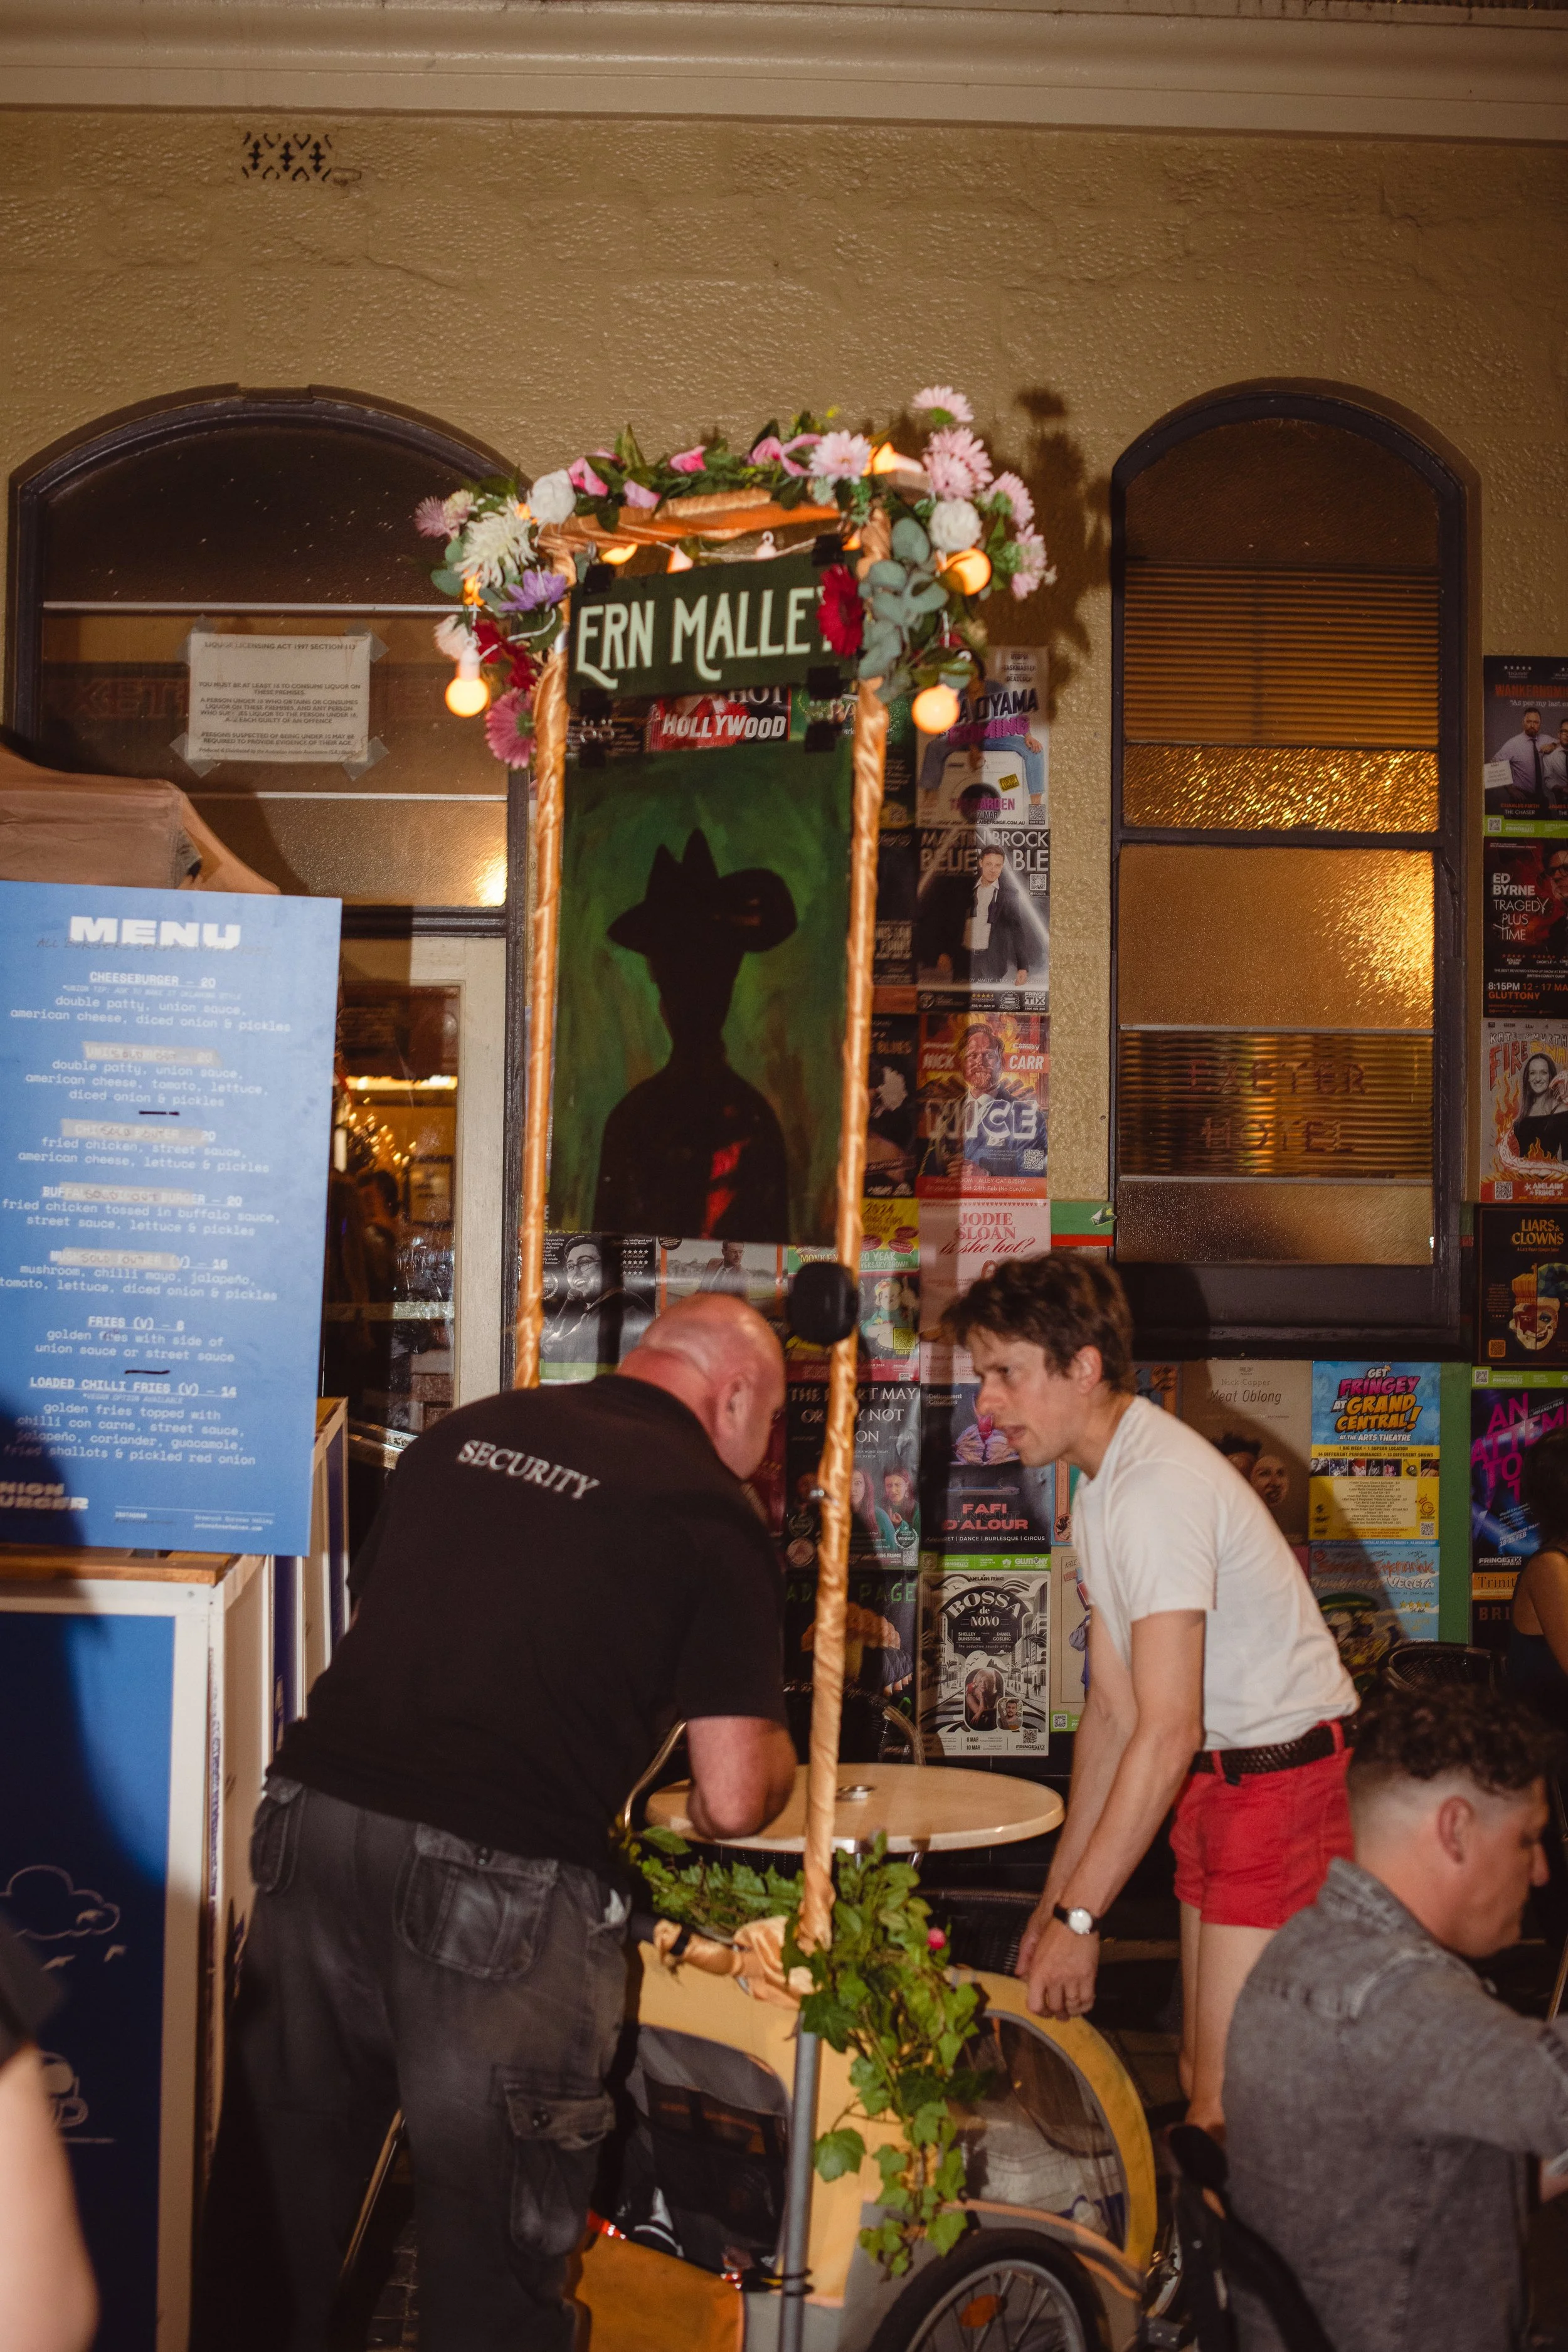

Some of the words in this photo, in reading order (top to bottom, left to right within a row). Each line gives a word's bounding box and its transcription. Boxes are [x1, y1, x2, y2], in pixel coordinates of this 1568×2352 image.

[576, 600, 655, 689] ERN
[671, 586, 832, 681] MALLE
[662, 713, 787, 738] HOLLYWOOD
[992, 831, 1049, 847] BROCK
[1492, 872, 1510, 884] ED
[1492, 885, 1535, 896] BYRNE
[1493, 897, 1549, 915] TRAGEDY
[1502, 913, 1528, 926] PLUS
[70, 915, 242, 950] MENU
[1491, 924, 1526, 940] TIME
[89, 971, 179, 988] CHEESEBURGER
[201, 977, 216, 989] 20
[1488, 982, 1520, 991] 8:15PM
[1025, 997, 1046, 1005] TIX
[1488, 992, 1540, 1000] GLUTTONY
[10, 1009, 70, 1021] american
[136, 1014, 174, 1027] diced
[180, 1016, 218, 1029] onion
[238, 1020, 292, 1033] pickles
[1009, 1054, 1045, 1070] CARR
[1490, 1041, 1528, 1091] FIRE
[1530, 1041, 1568, 1065] SNA
[960, 1212, 1014, 1226] JODIE
[1522, 1219, 1555, 1232] LIARS
[958, 1226, 1017, 1240] SLOAN
[1511, 1232, 1564, 1246] CLOWNS
[958, 1239, 990, 1254] she
[992, 1237, 1036, 1254] hot?
[81, 1252, 111, 1264] SOLD
[873, 1252, 897, 1261] YEAR
[88, 1315, 126, 1330] FRIES
[133, 1316, 155, 1331] (V)
[1367, 1367, 1389, 1378] GET
[29, 1376, 75, 1390] LOADED
[81, 1379, 127, 1392] CHILLI
[132, 1381, 171, 1395] FRIES
[177, 1384, 199, 1397] (V)
[1242, 1379, 1271, 1387] Capper
[1338, 1375, 1421, 1397] FRINGEY
[882, 1387, 917, 1400] MAY
[1209, 1389, 1239, 1404] Meat
[1242, 1389, 1282, 1406] Oblong
[1332, 1399, 1347, 1411] AT
[1346, 1394, 1417, 1416] GRAND
[869, 1409, 904, 1421] NOT
[1335, 1406, 1423, 1433] CENTRAL!
[1486, 1392, 1528, 1440] AN
[129, 1449, 183, 1463] pickled
[189, 1453, 212, 1464] red
[218, 1454, 256, 1466] onion
[457, 1439, 601, 1500] SECURITY
[962, 1503, 1007, 1514] FAFI
[943, 1519, 1029, 1530] D'ALOUR
[1066, 1559, 1078, 1569] KYLE
[1387, 1577, 1434, 1591] VEGETA
[1478, 1576, 1517, 1588] Trinit
[945, 1590, 1021, 1619] BOSSA
[979, 1606, 990, 1614] de
[1478, 1606, 1510, 1621] BRI
[970, 1616, 1000, 1626] NOVO
